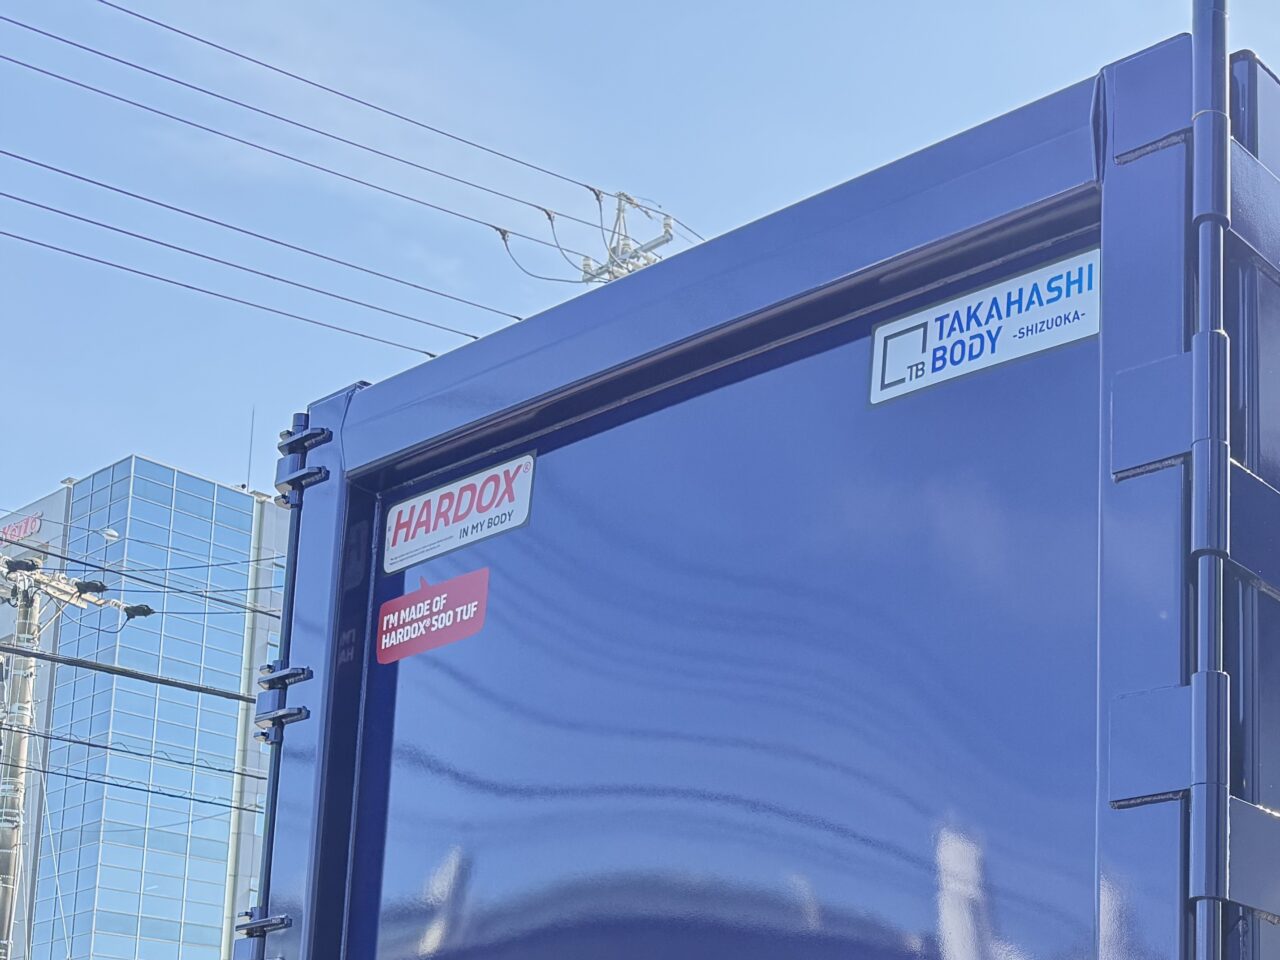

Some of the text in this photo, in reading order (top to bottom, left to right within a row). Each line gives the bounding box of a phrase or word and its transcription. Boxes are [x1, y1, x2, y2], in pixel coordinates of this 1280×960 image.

[935, 263, 1094, 341] TAKAHASHI
[931, 310, 1086, 374] BODY -SHIZUOKA-
[906, 361, 926, 382] TB
[459, 510, 514, 539] IN MY BODY
[382, 594, 448, 631] I'M MADE OF
[431, 610, 454, 631] 500
[456, 601, 479, 623] TUF
